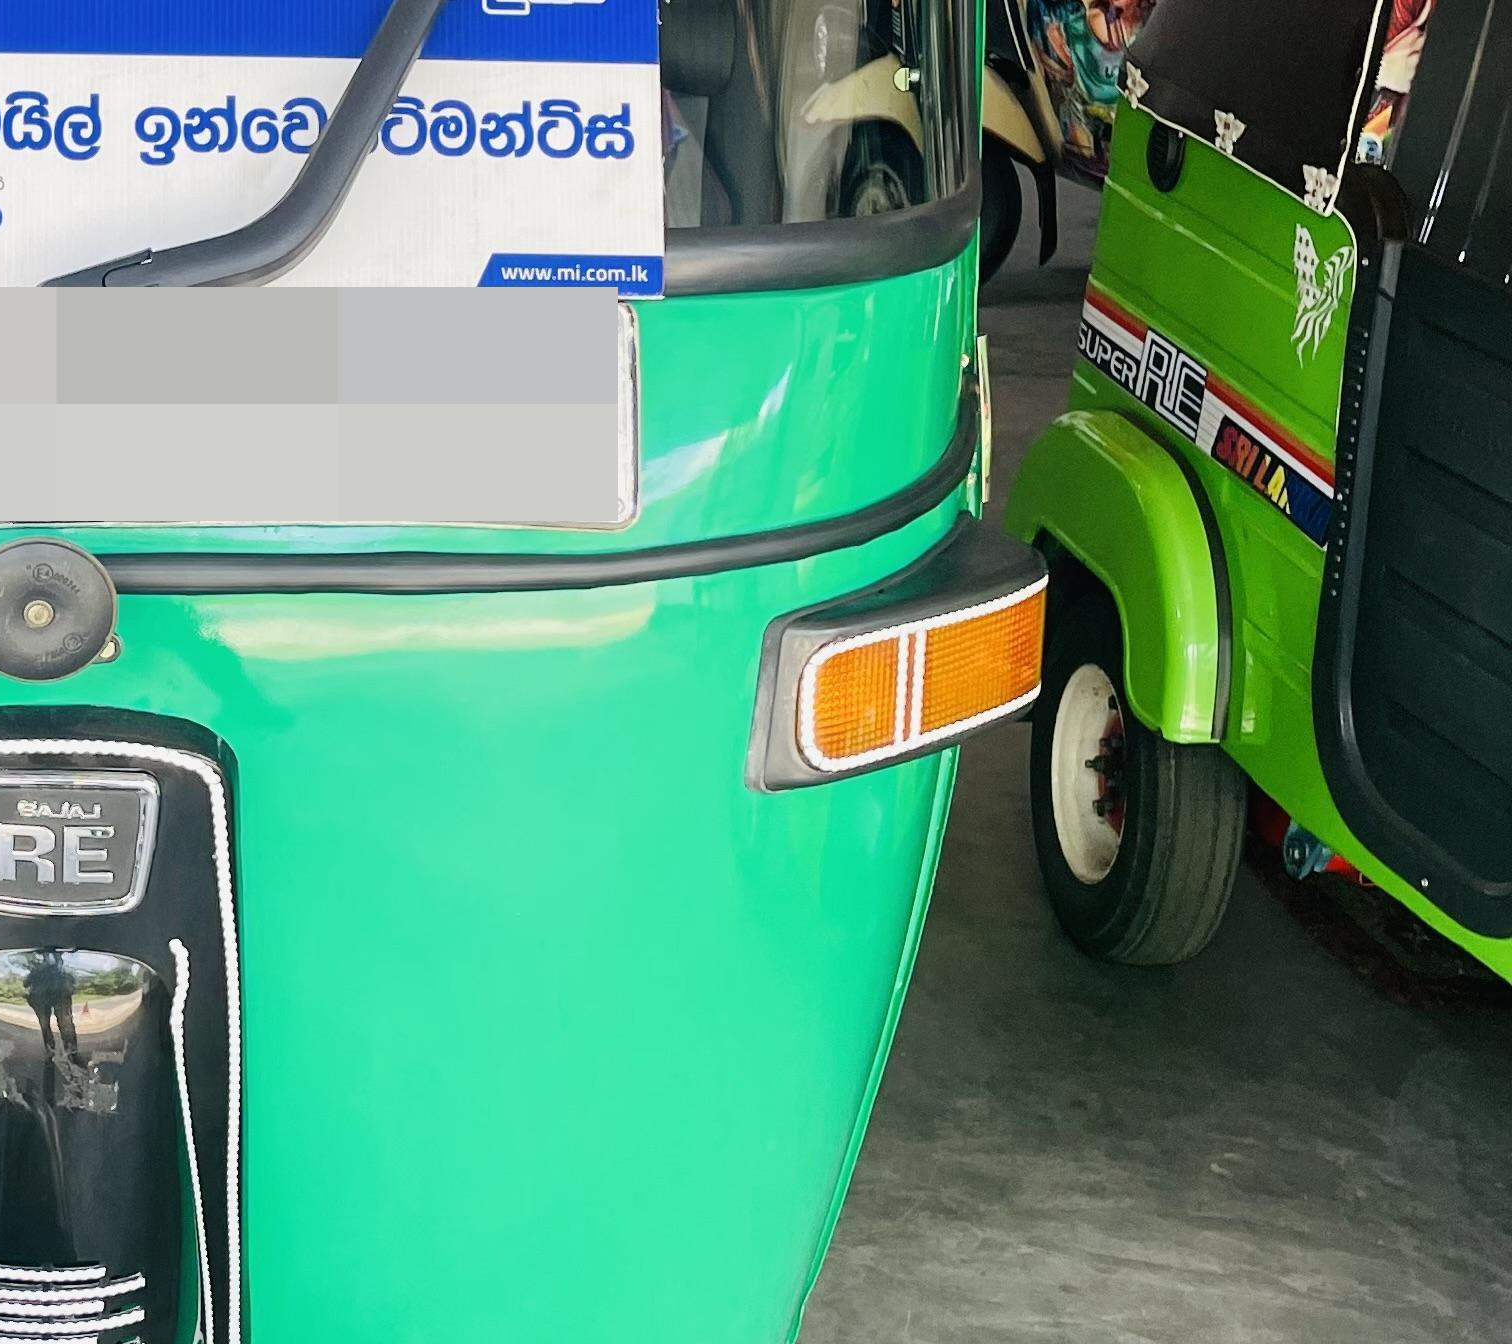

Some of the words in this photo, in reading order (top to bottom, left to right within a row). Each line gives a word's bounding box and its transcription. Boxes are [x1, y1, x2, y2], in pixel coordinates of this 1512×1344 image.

[500, 263, 648, 282] www.mi.com.lk
[1077, 322, 1137, 391] SUPER
[1136, 329, 1208, 441] RE
[17, 799, 101, 819] BAJAJ
